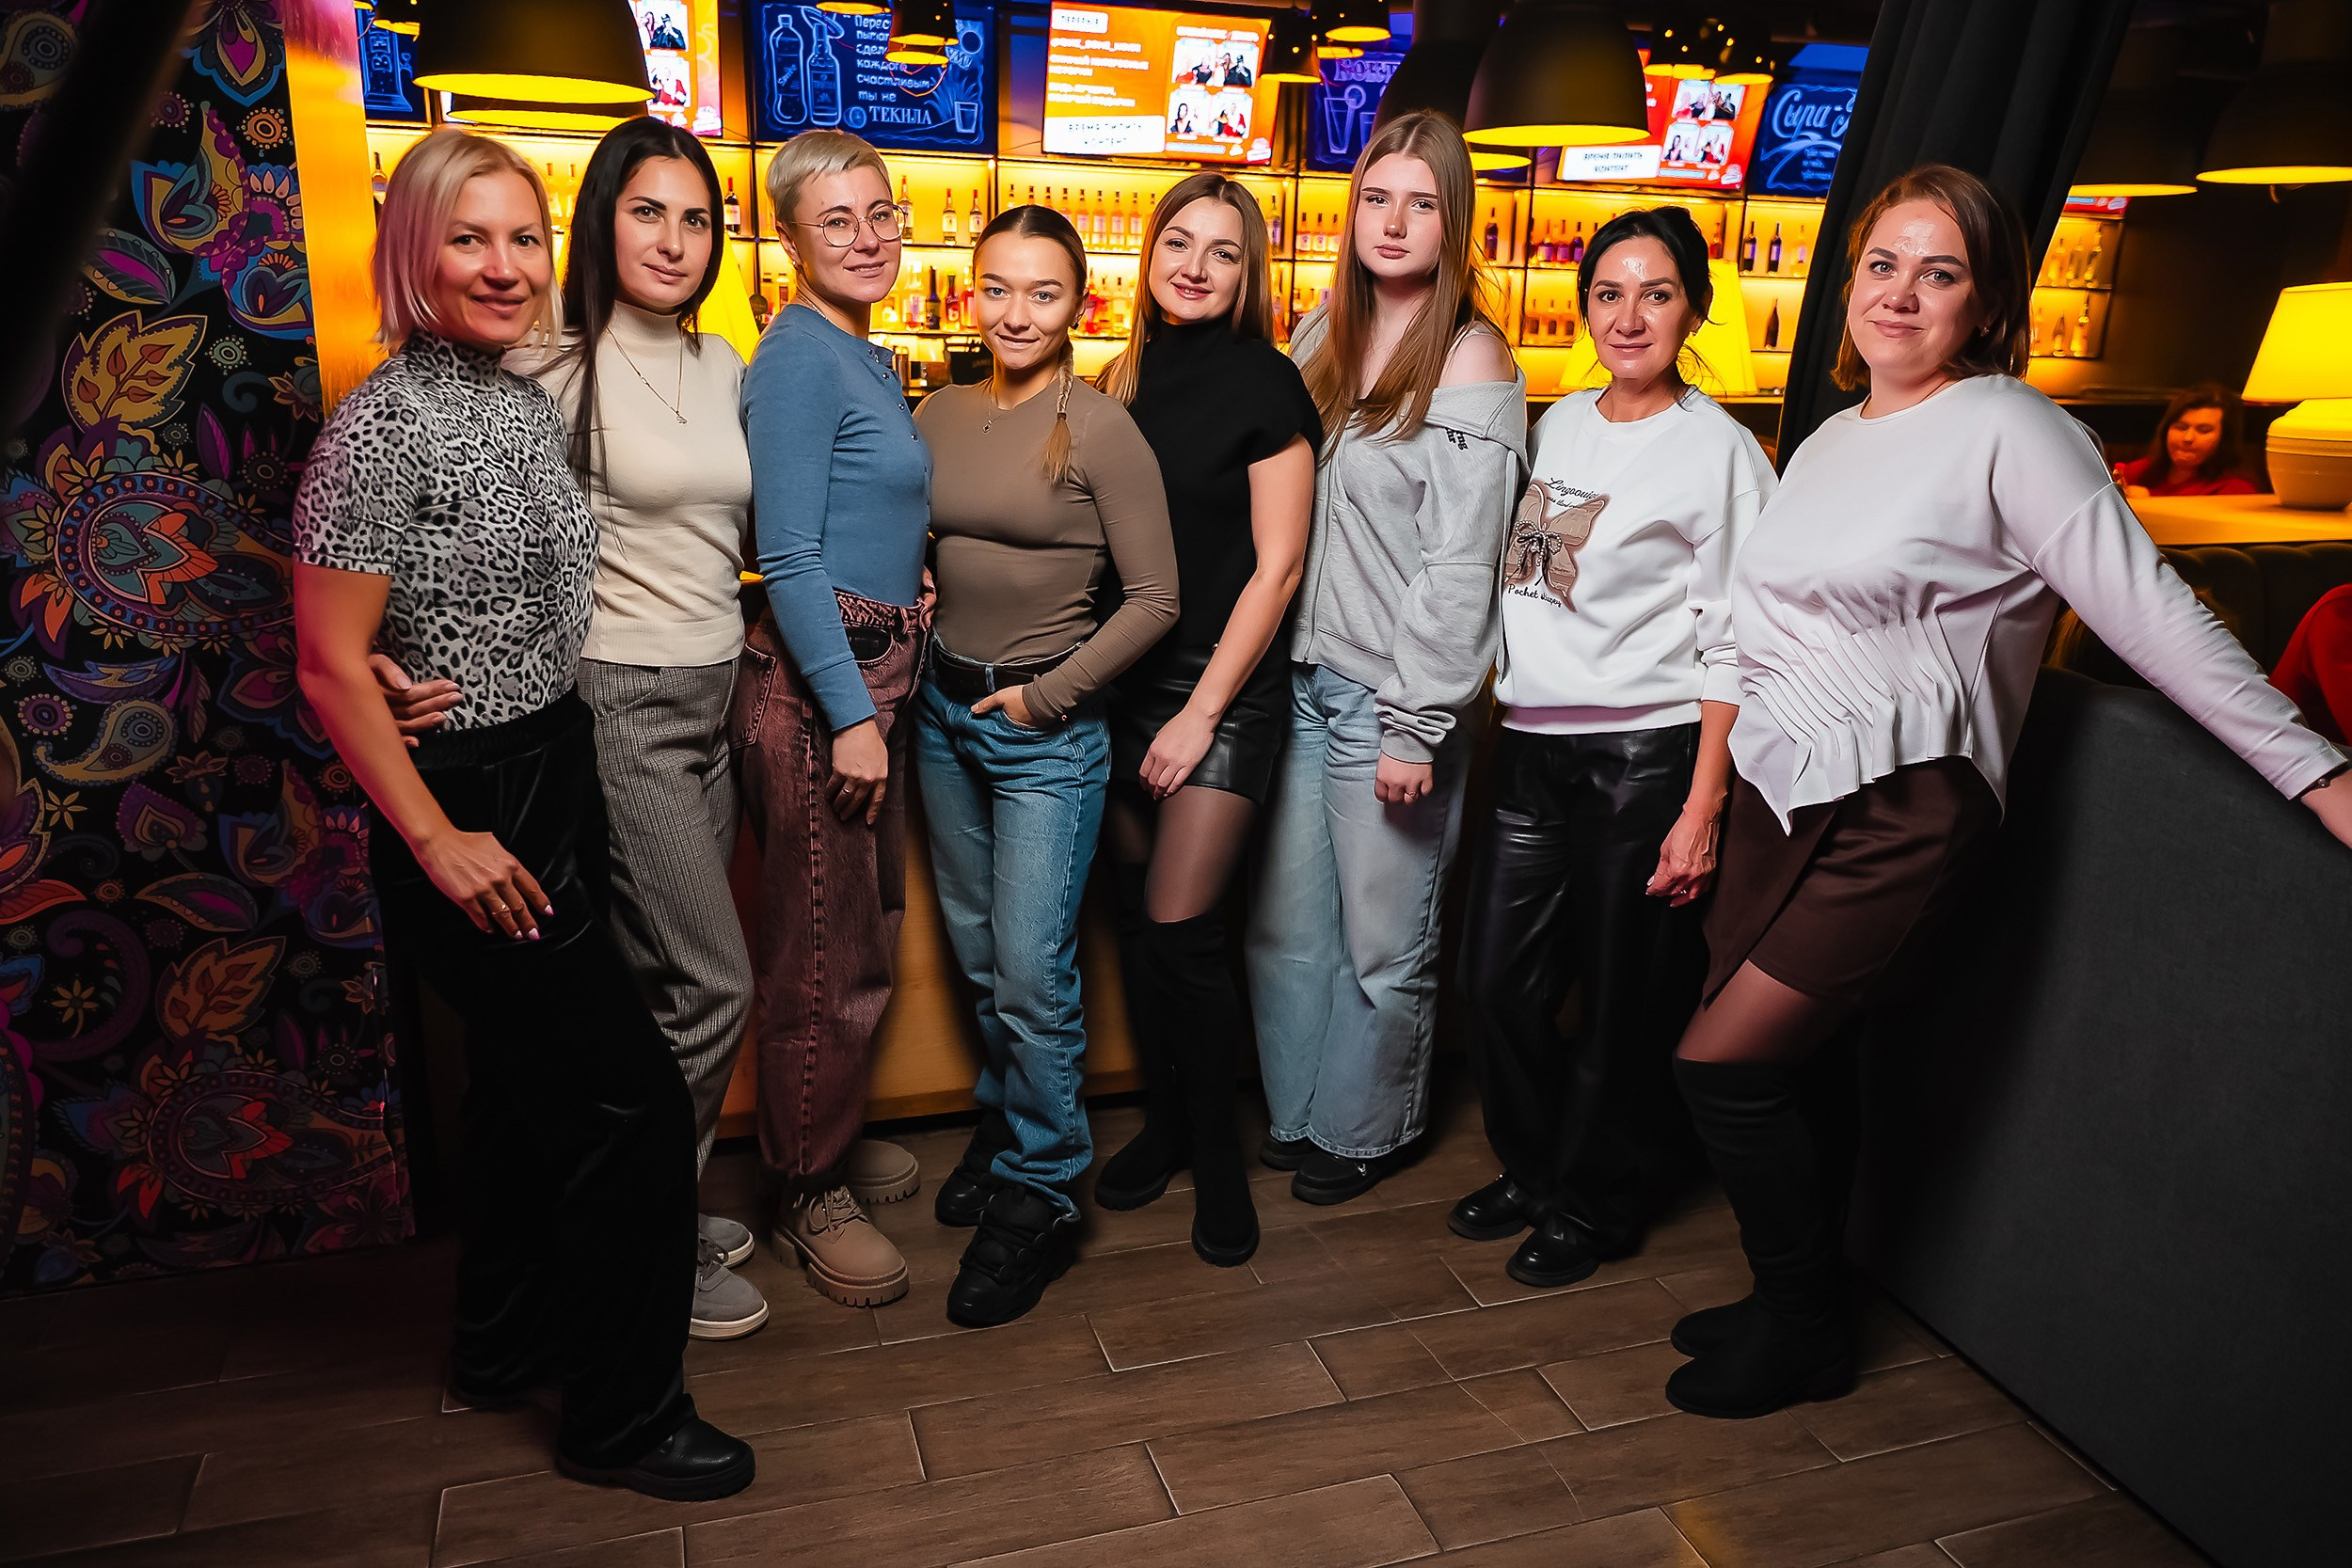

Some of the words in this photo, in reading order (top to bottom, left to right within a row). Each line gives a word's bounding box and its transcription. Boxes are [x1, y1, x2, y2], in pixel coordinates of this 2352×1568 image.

[854, 14, 892, 30] Перес
[882, 92, 897, 103] не
[868, 105, 932, 125] ТЕКИЛА
